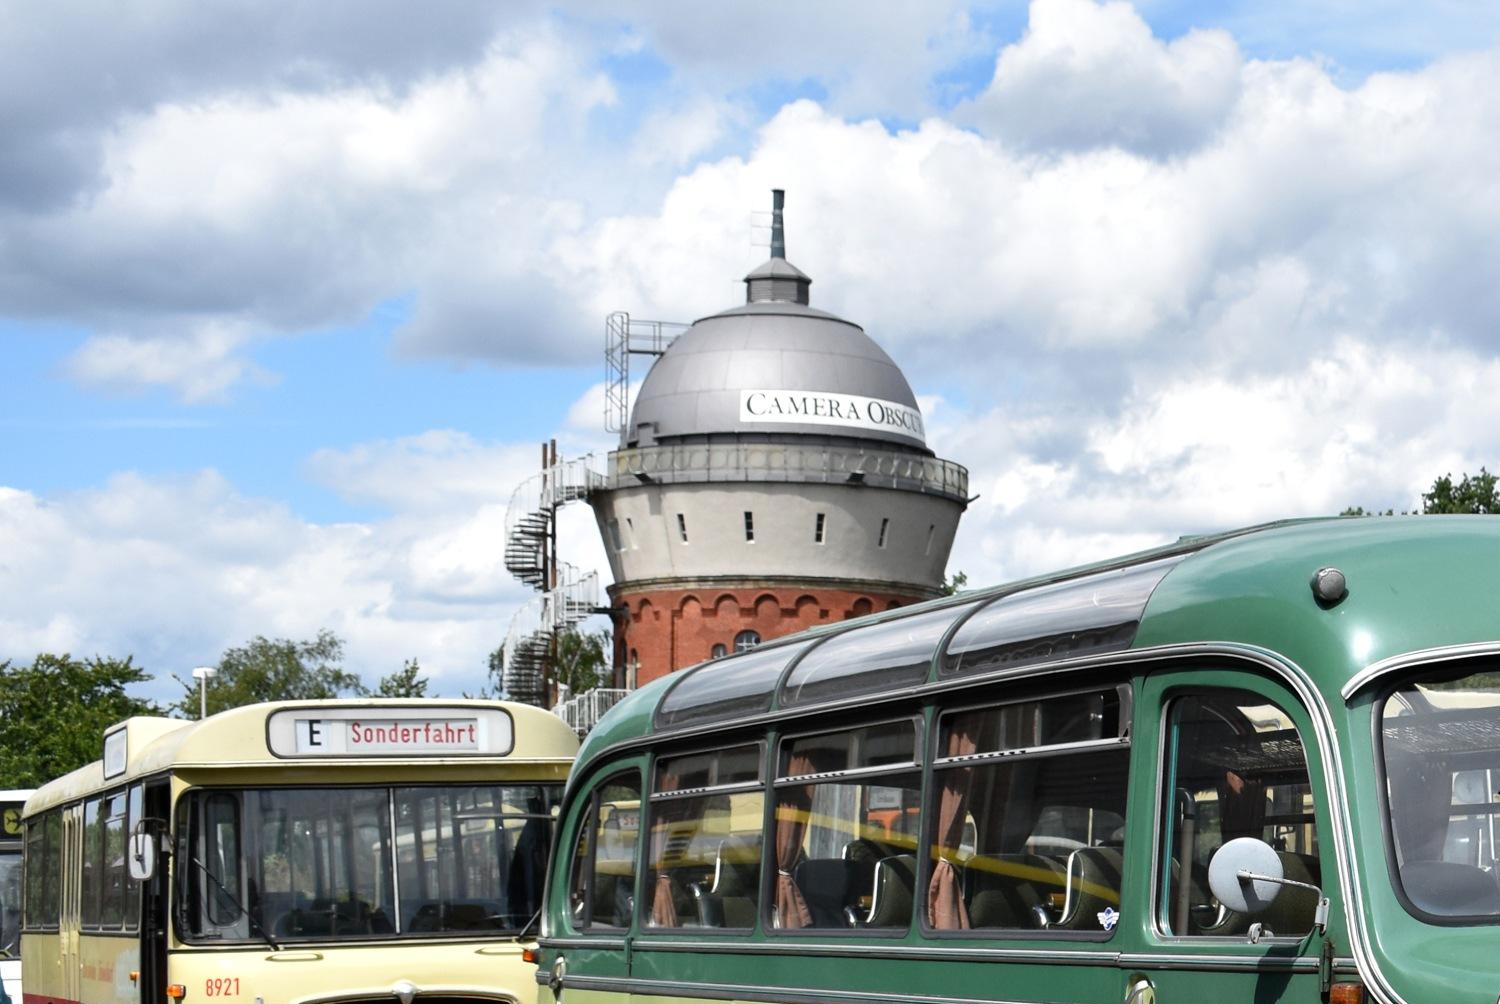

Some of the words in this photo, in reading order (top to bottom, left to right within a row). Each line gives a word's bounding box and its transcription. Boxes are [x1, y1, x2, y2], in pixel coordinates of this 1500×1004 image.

[746, 392, 861, 420] CAMERA
[308, 720, 322, 746] E
[351, 722, 476, 743] Sonderfahrt
[206, 977, 240, 997] 8921
